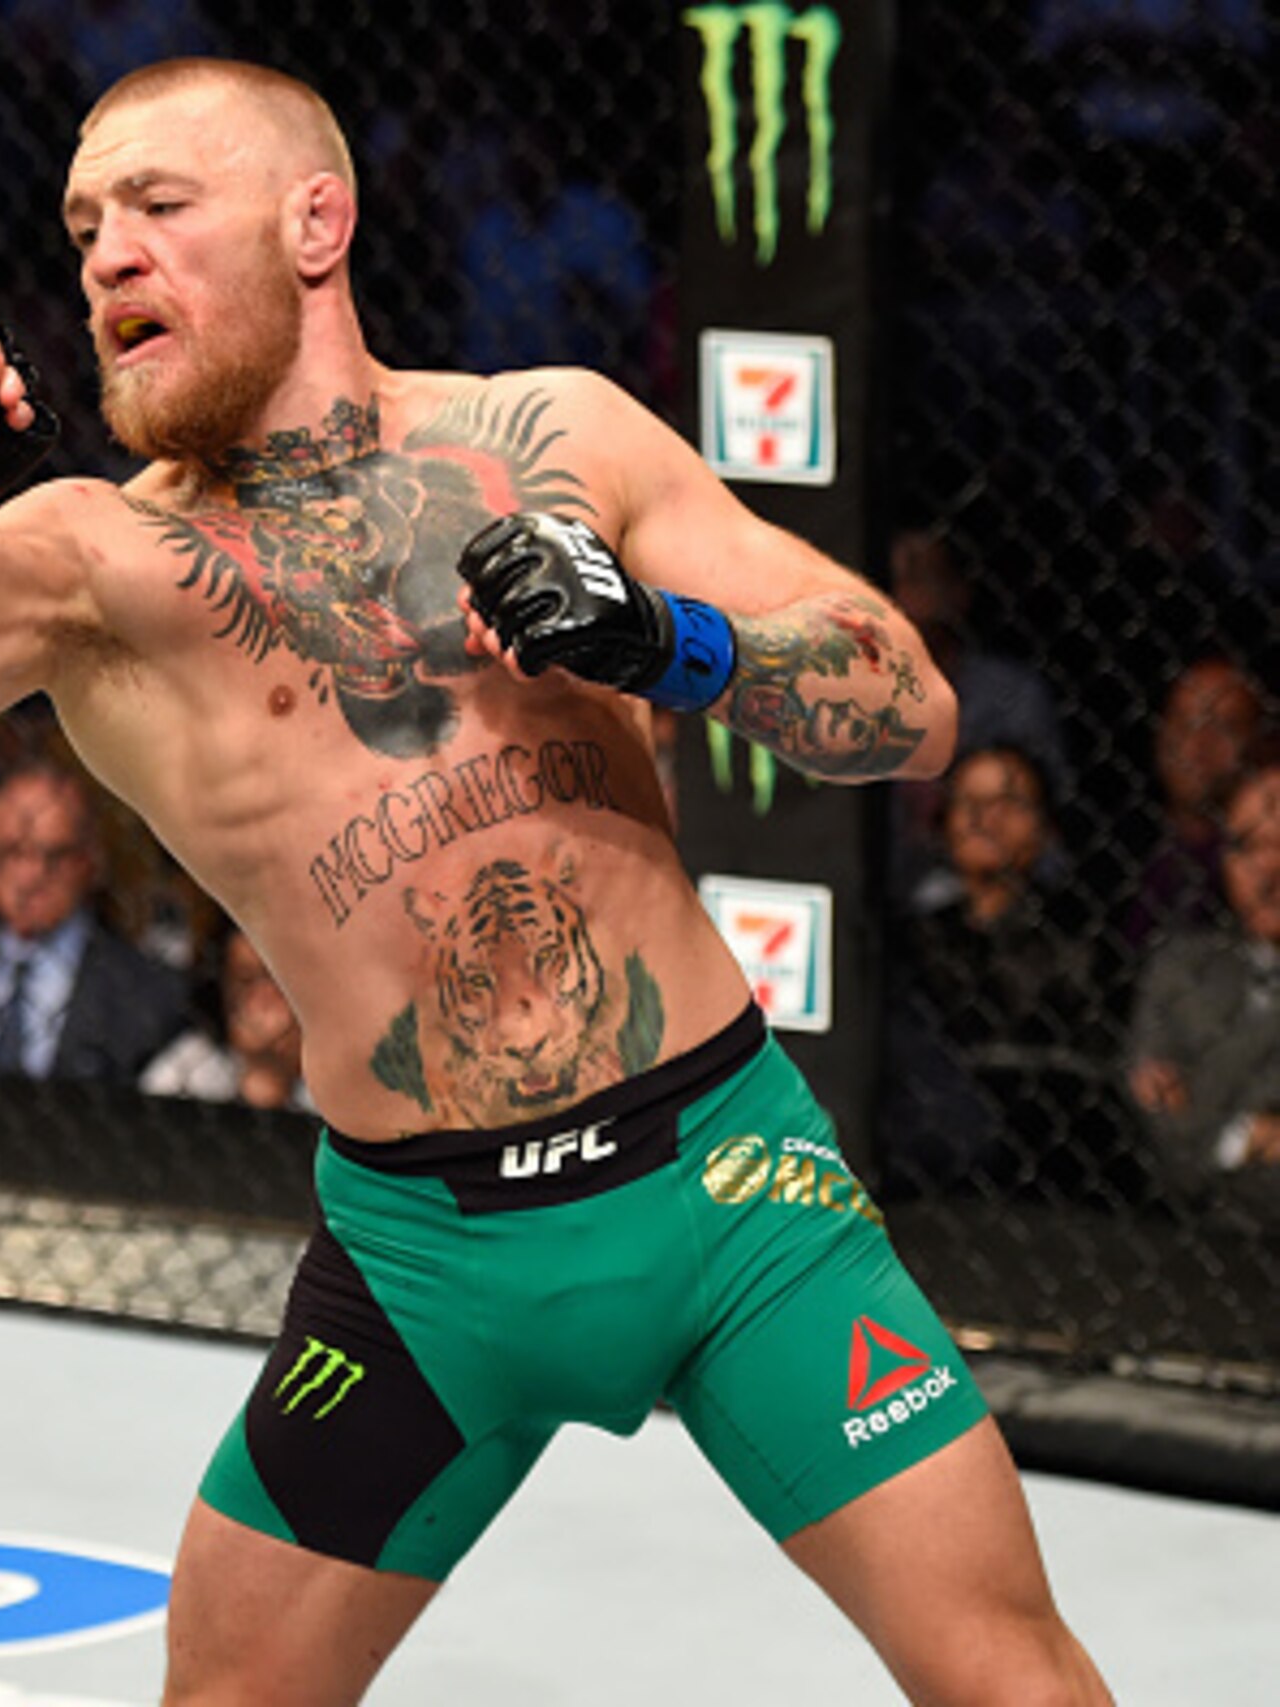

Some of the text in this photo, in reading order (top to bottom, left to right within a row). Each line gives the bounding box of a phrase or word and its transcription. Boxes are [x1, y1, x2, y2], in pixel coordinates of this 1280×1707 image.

[309, 740, 617, 930] MCGREGOR
[499, 1116, 618, 1178] UFC
[842, 1365, 958, 1448] Reebok
